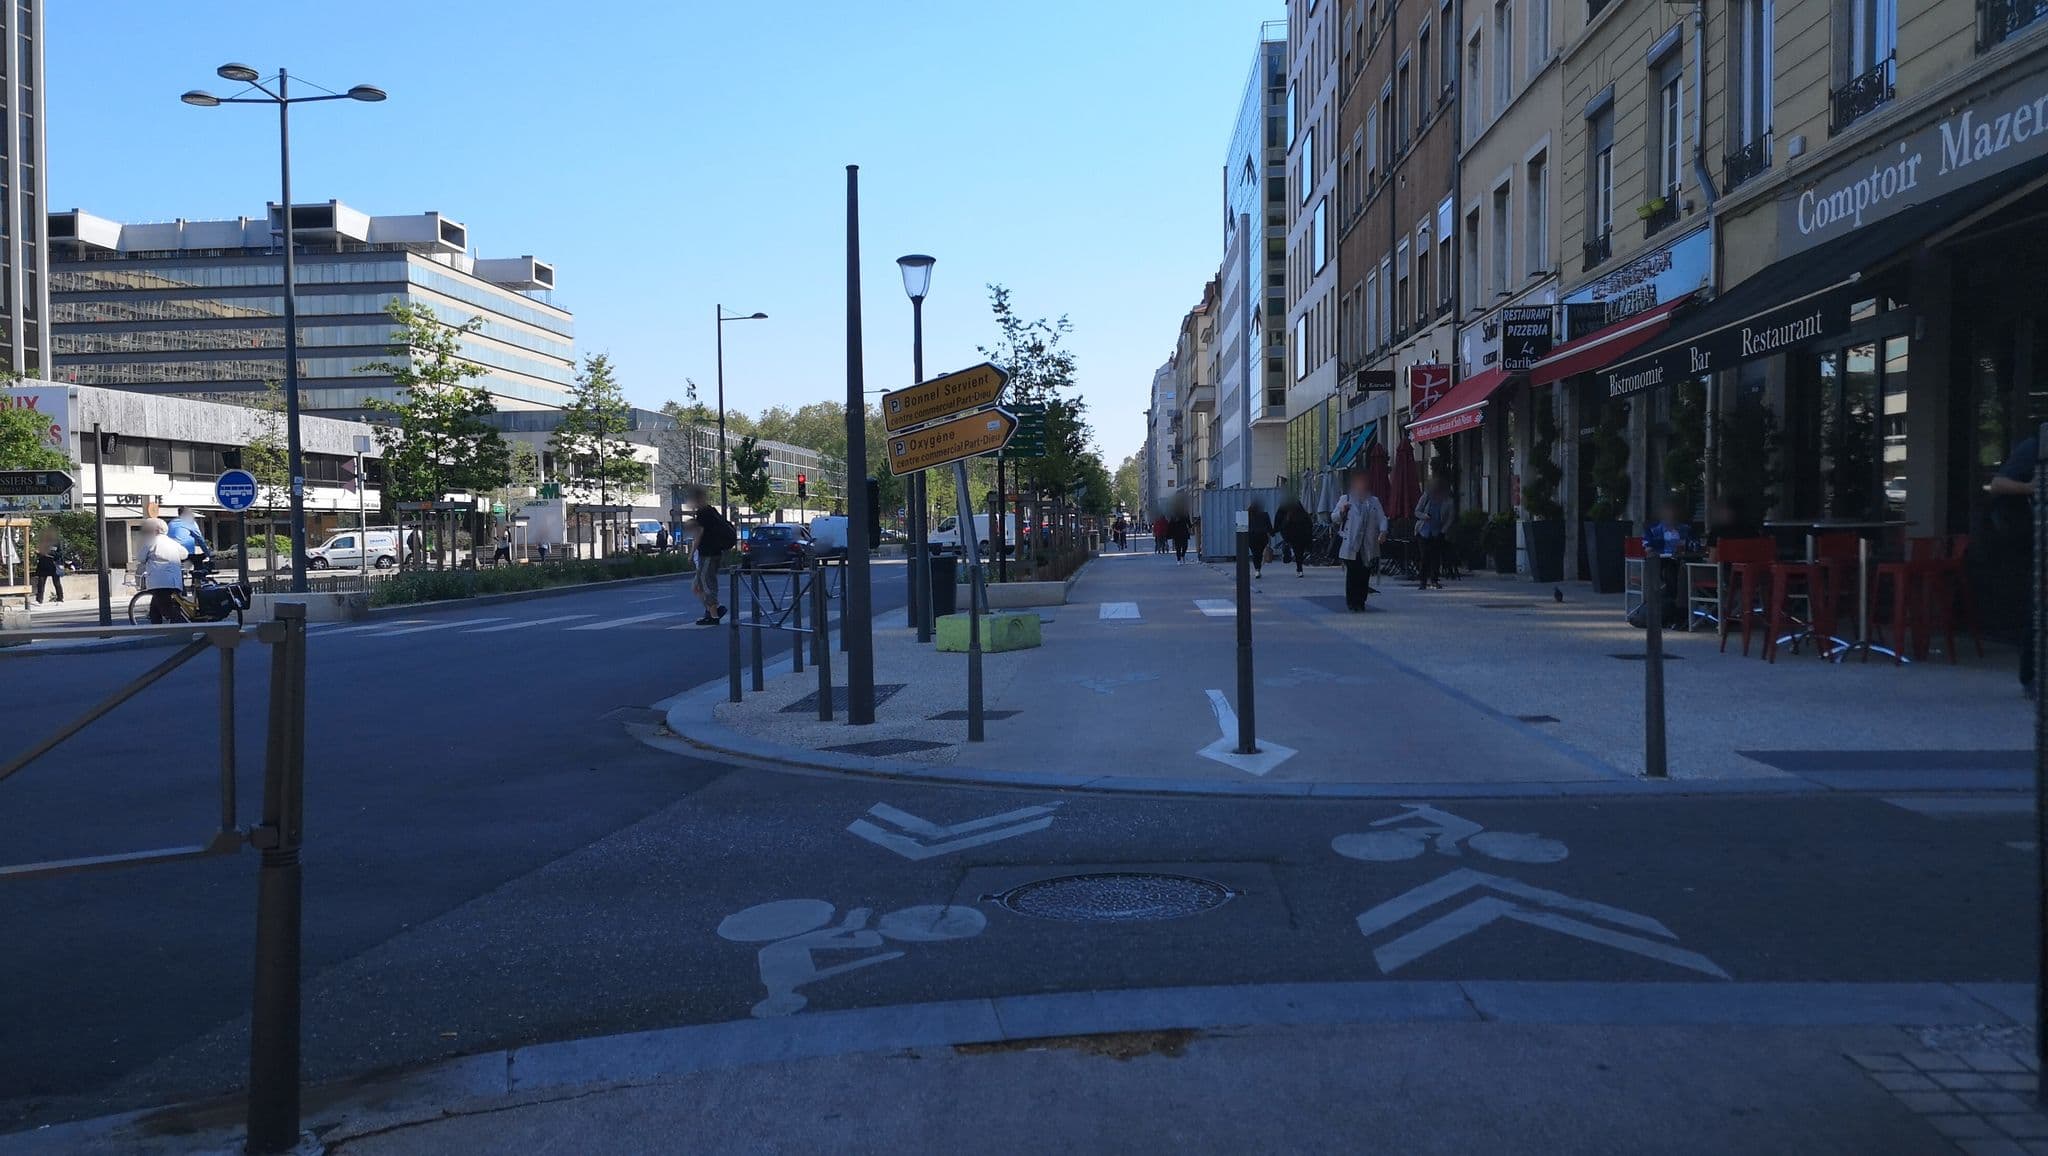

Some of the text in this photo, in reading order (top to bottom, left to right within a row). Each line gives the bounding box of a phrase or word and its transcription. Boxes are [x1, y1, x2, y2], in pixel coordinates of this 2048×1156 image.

[1798, 142, 1922, 235] Comptoir
[1503, 308, 1551, 321] RESTAURANT
[1507, 324, 1548, 336] PIZZERIA
[1520, 340, 1536, 355] Le
[1609, 308, 1823, 398] Bistronomie Bar Restaurant
[890, 412, 913, 426] centre
[914, 398, 956, 419] commercial
[955, 389, 992, 407] Part-Dieu
[904, 387, 940, 408] Bonnel
[944, 373, 989, 396] Servient
[896, 433, 1000, 469] centre commercial Part-Dieu
[909, 430, 956, 451] Oxygène
